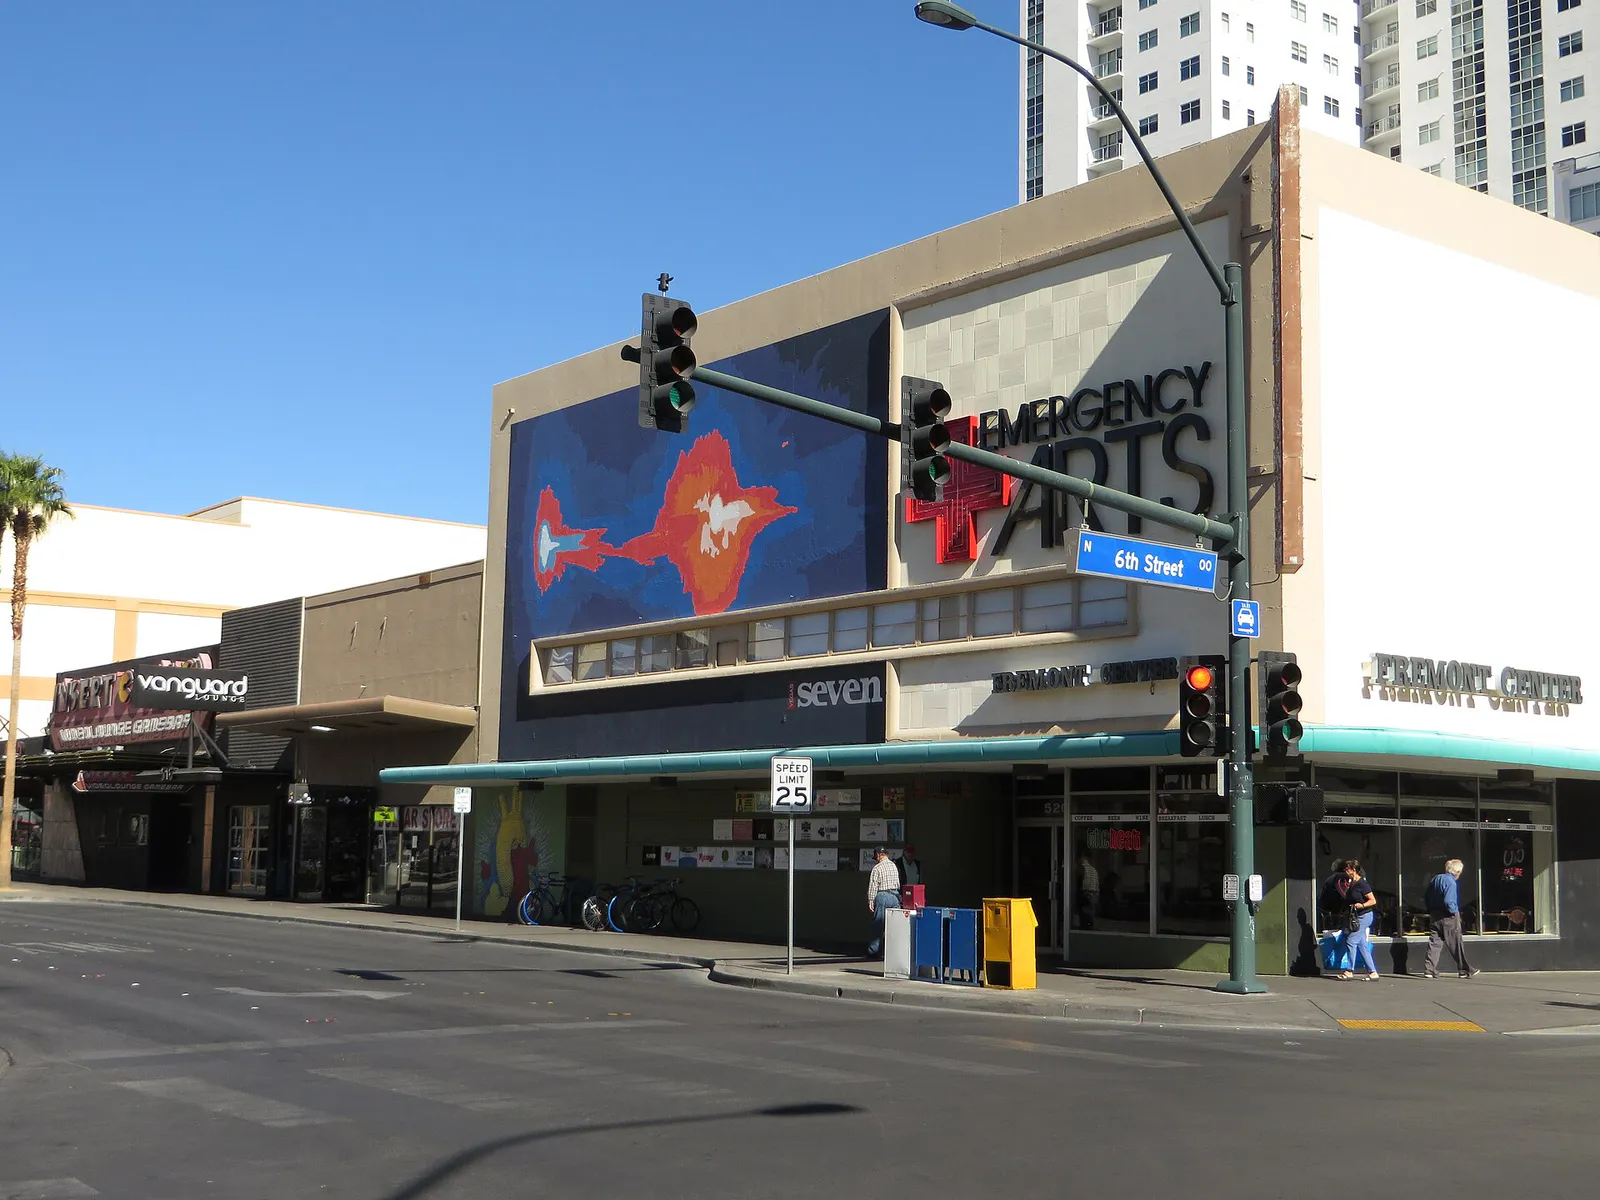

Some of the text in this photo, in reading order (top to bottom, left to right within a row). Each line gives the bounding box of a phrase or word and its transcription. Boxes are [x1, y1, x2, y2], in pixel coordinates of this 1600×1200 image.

[979, 361, 1212, 450] EMERGENCY
[991, 413, 1214, 556] ARTS
[1083, 540, 1092, 553] N
[1114, 549, 1139, 571] 6th
[1143, 554, 1184, 578] Street
[137, 675, 248, 699] vanguard
[991, 656, 1179, 694] FREMONT CENTER
[1370, 652, 1583, 704] FREMONT CENTER
[194, 693, 245, 703] LOUNGE
[797, 675, 883, 708] seven
[59, 713, 191, 742] VIDEOLOUNGE GAMEBAR
[776, 763, 809, 773] SPEED
[779, 775, 805, 784] LIMIT
[143, 783, 184, 791] GAMEBAR
[775, 786, 808, 807] 25
